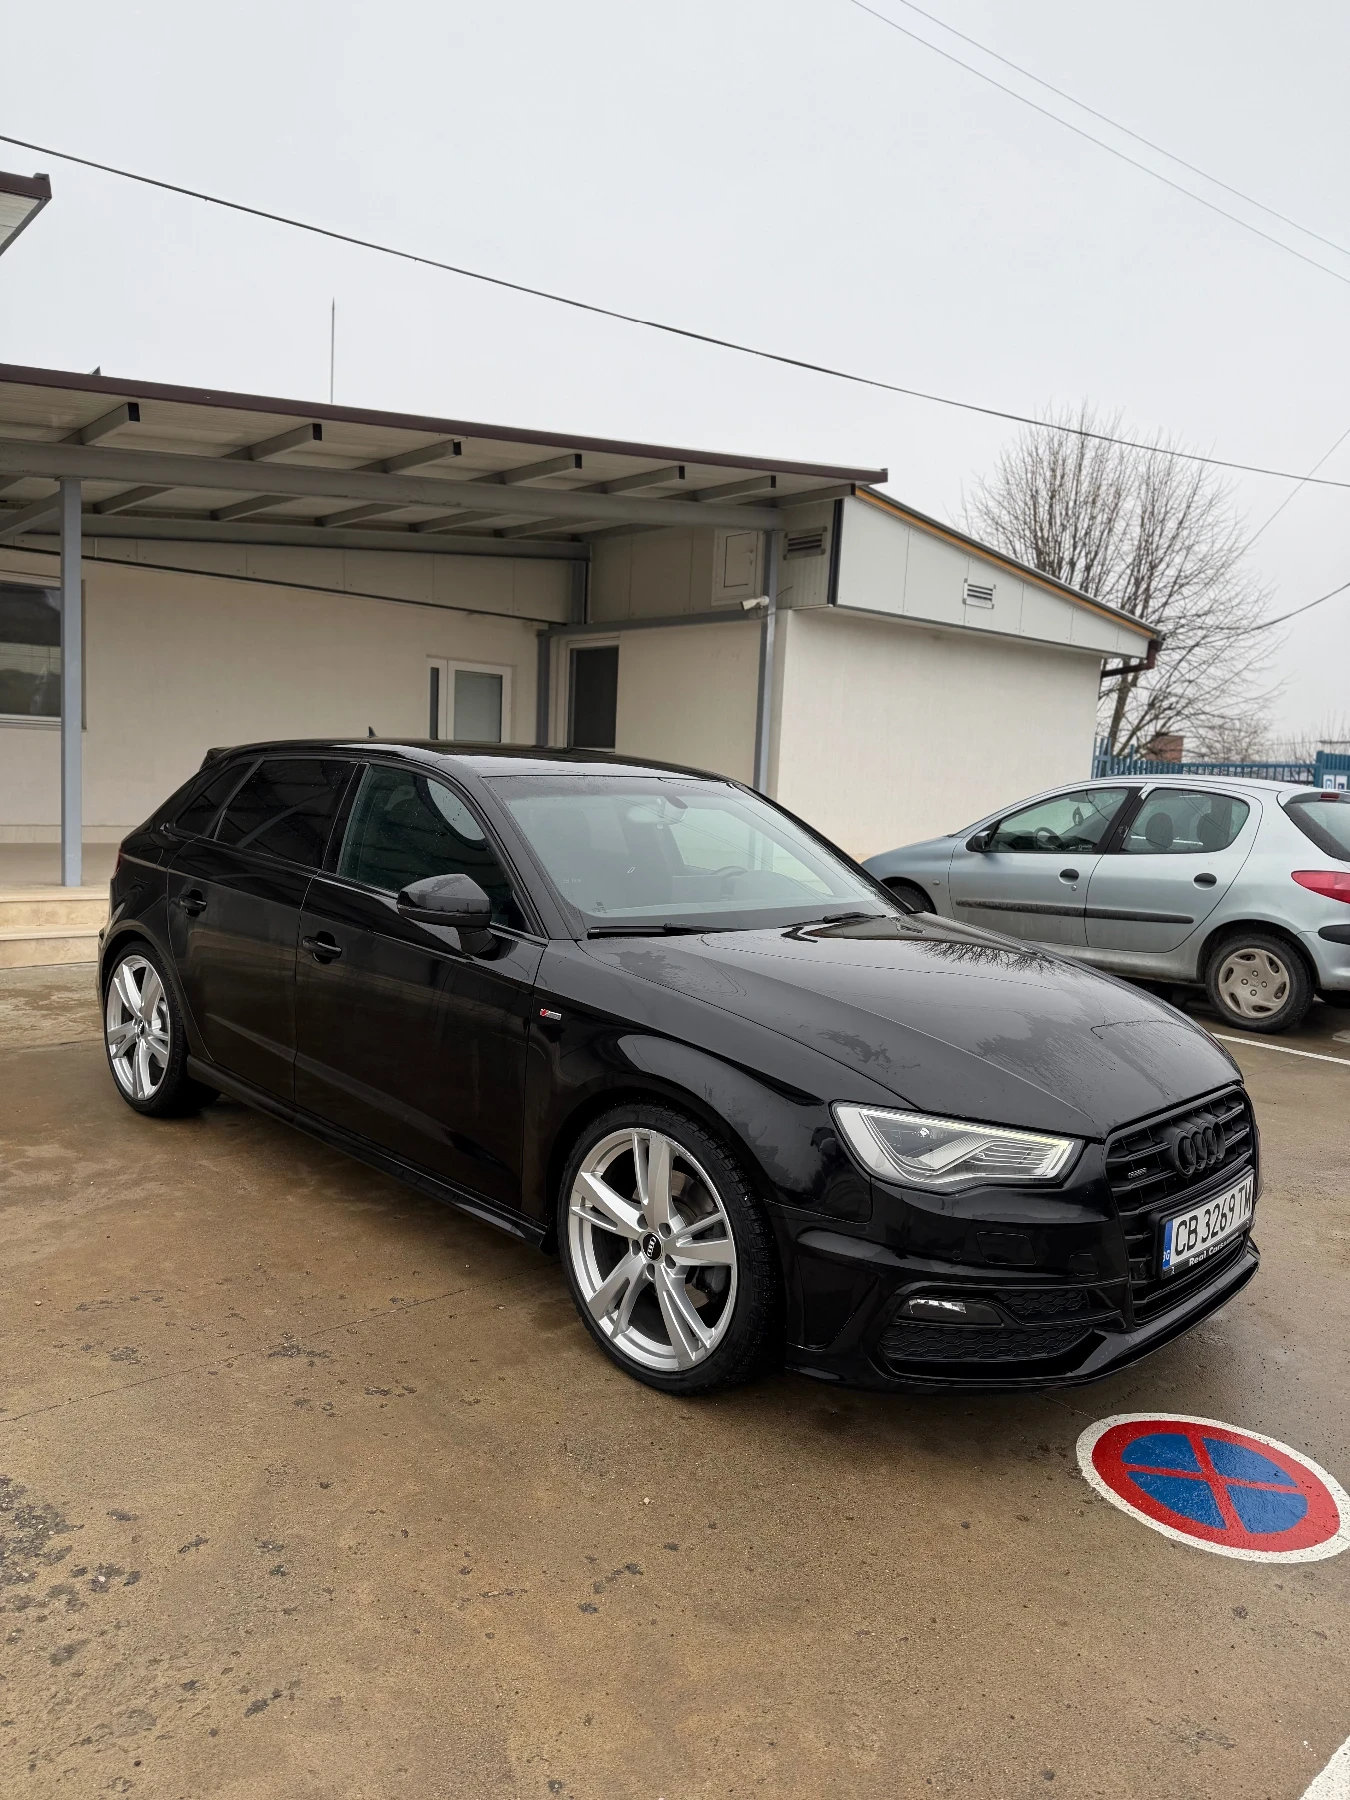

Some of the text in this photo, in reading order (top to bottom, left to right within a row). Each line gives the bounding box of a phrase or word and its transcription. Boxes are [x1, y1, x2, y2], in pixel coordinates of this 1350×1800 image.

[1174, 1179, 1252, 1256] CB 3269 TM
[1188, 1251, 1207, 1266] Real
